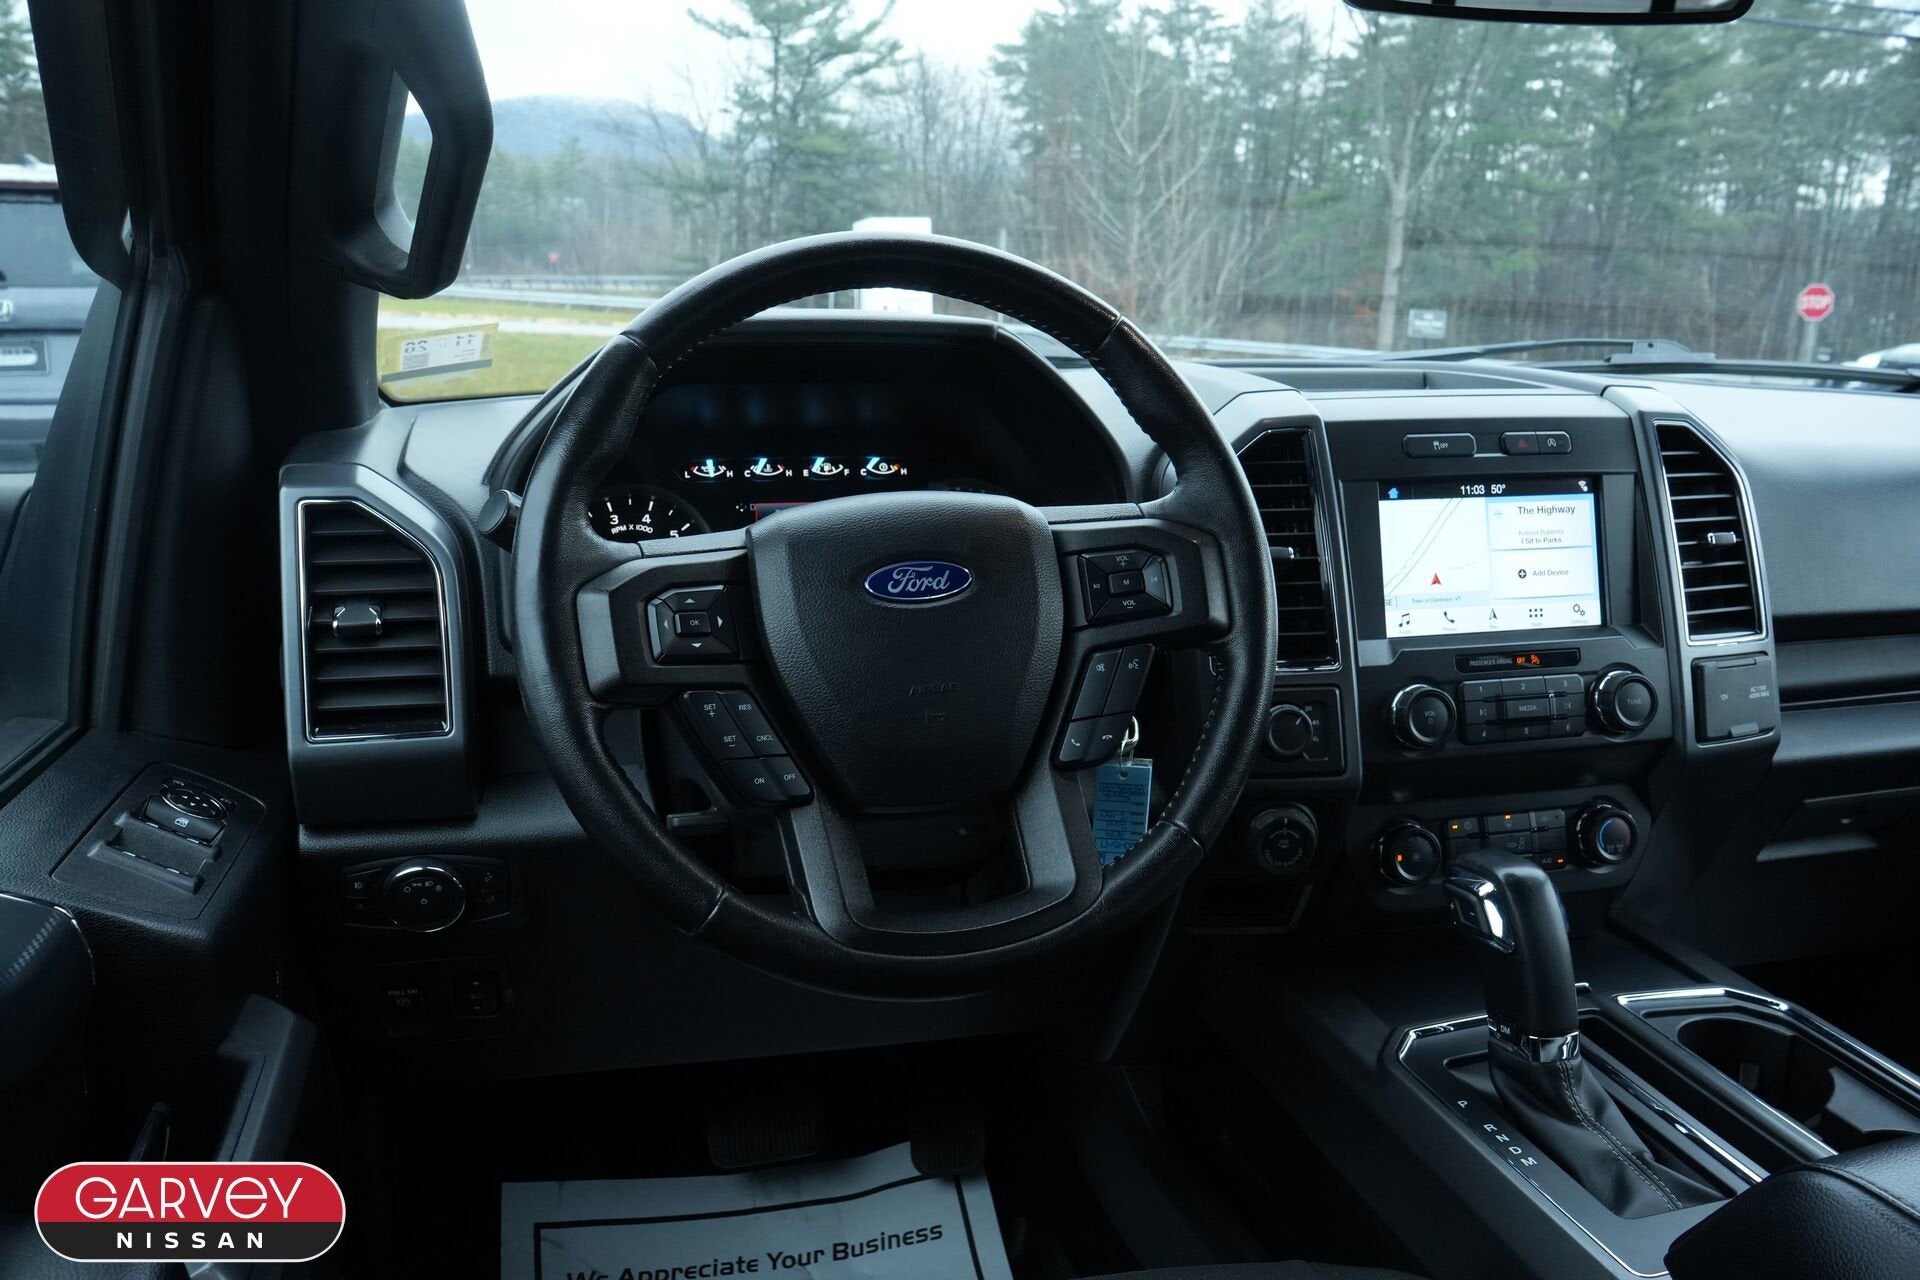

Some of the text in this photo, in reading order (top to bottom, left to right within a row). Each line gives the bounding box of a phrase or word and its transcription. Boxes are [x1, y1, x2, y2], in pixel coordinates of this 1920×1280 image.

[684, 470, 734, 479] L H
[744, 470, 793, 478] C H
[803, 469, 850, 477] E F
[860, 468, 908, 477] C H
[1460, 485, 1485, 495] 11:03
[1517, 505, 1576, 516] The Highway
[609, 513, 679, 538] 3 4 5
[610, 524, 627, 535] RPM
[635, 524, 654, 534] 1000
[1115, 554, 1129, 562] VOL
[887, 565, 951, 594] Ford
[724, 735, 736, 743] SET
[754, 777, 765, 785] ON
[1457, 1100, 1538, 1167] P R N D M
[767, 1250, 825, 1271] Your
[832, 1224, 943, 1262] Business
